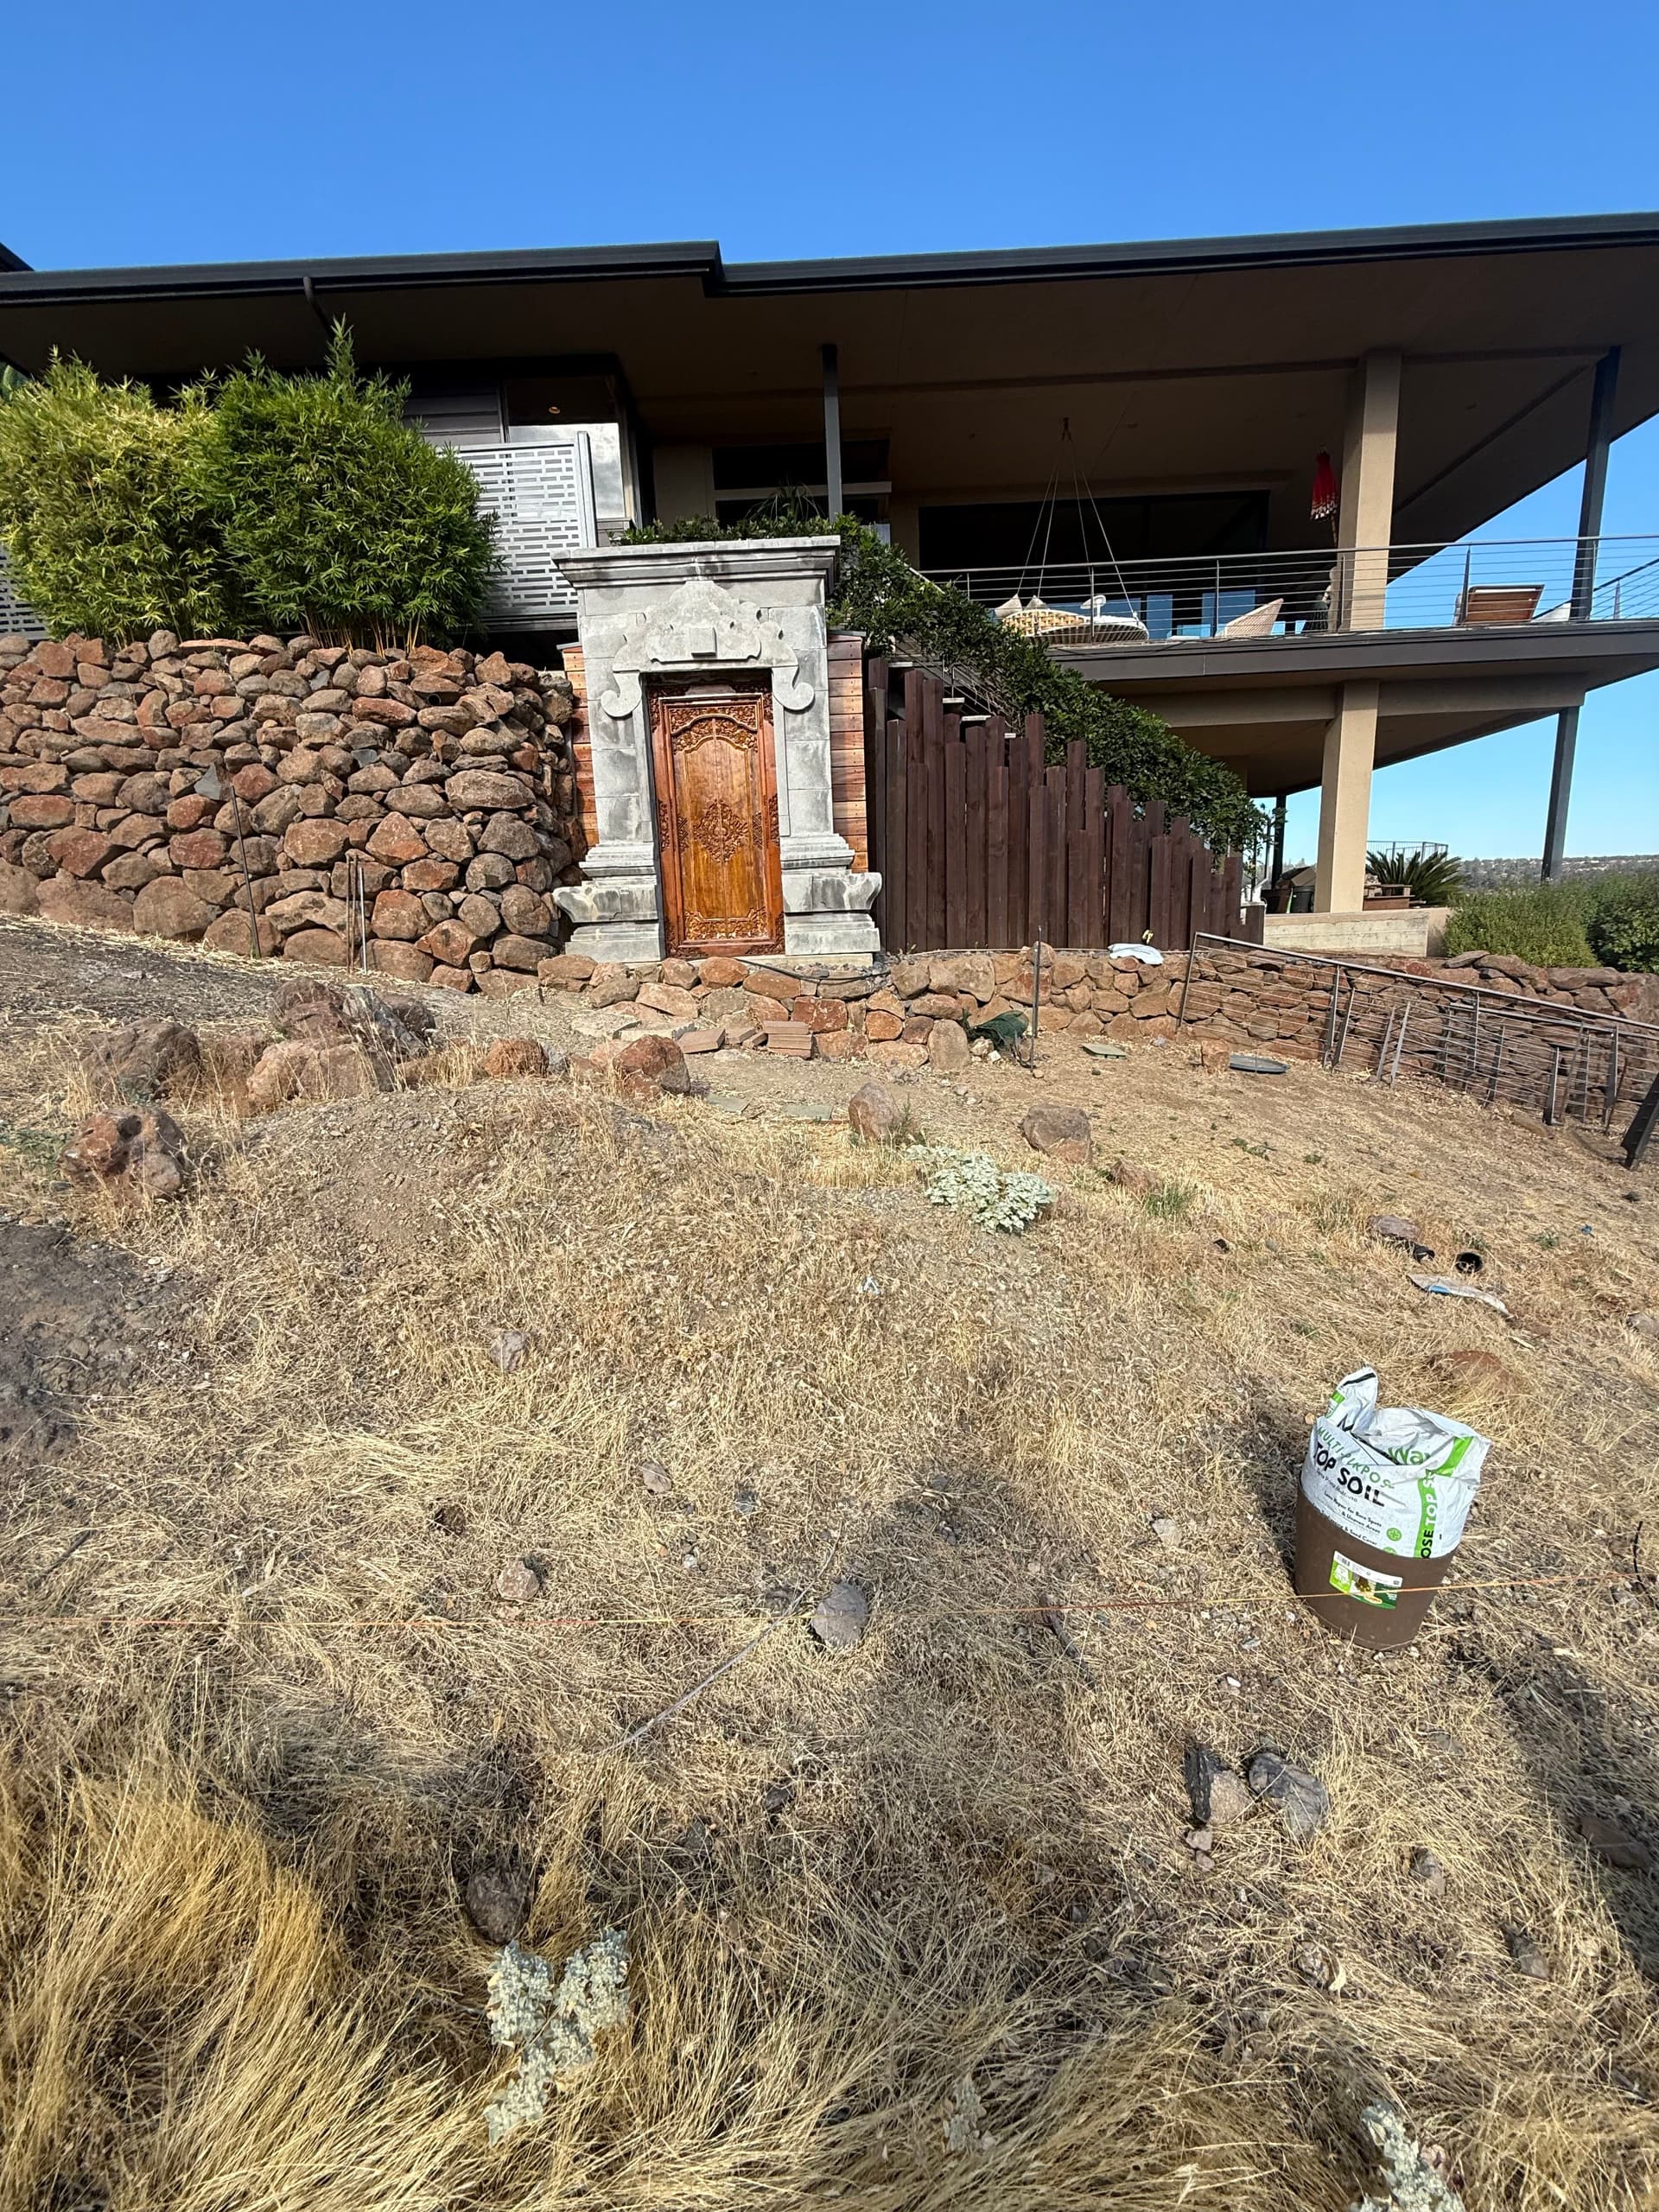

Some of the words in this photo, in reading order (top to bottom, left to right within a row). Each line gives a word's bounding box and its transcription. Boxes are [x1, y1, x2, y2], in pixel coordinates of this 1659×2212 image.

[1313, 1441, 1337, 1471] TOP
[1337, 1467, 1384, 1507] SOIL
[1425, 1493, 1438, 1526] TOP
